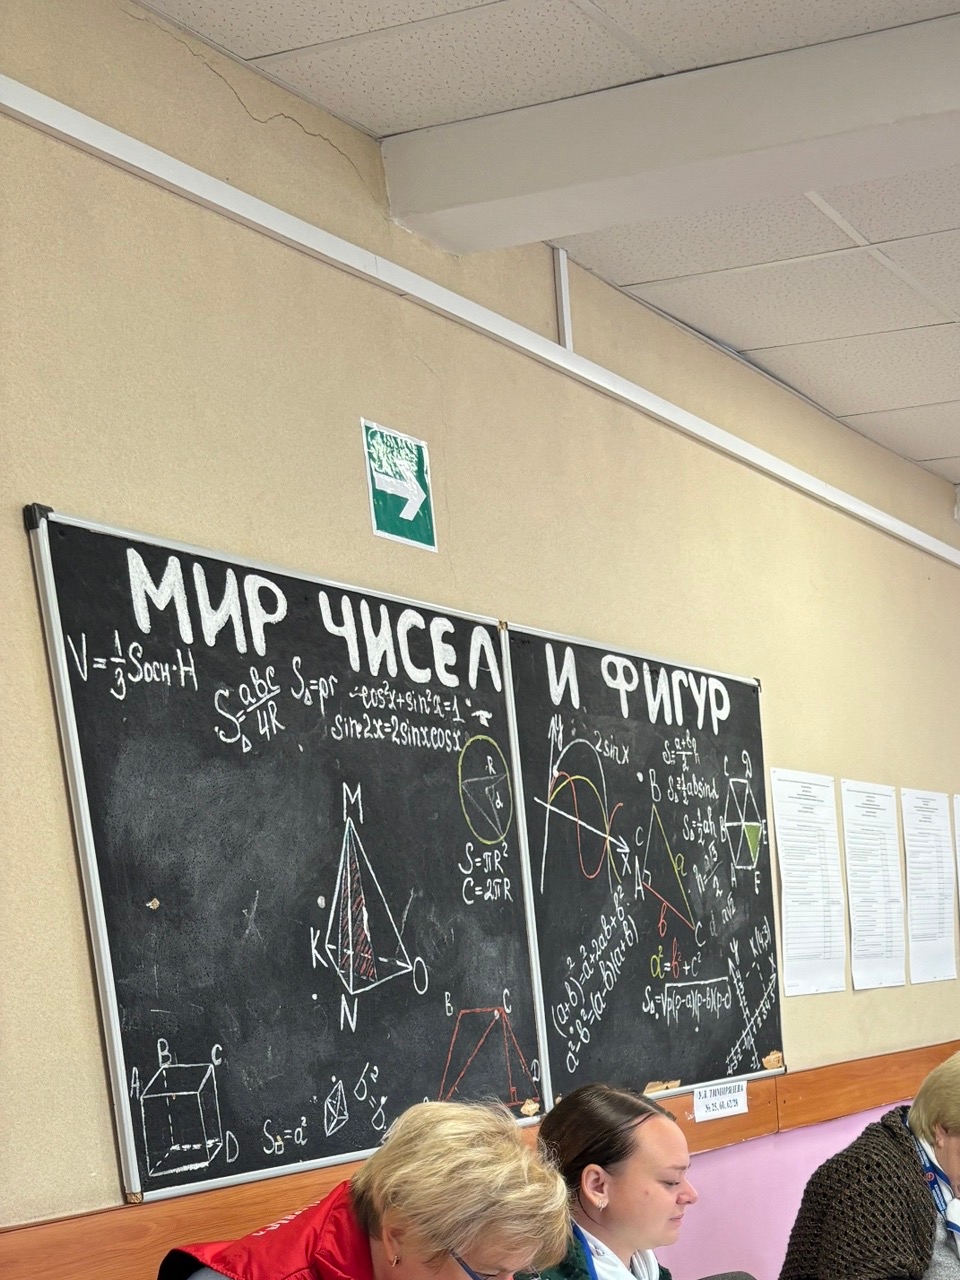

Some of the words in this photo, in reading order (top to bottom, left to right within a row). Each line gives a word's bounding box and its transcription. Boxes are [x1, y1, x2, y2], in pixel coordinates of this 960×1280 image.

[126, 547, 288, 657] МИР
[318, 590, 502, 692] ЧИСЕЛ
[545, 642, 580, 710] И
[600, 653, 731, 736] ФИГУР
[342, 782, 363, 824] M
[462, 877, 513, 905] C=2πR
[310, 927, 328, 968] K
[340, 994, 358, 1033] N
[503, 989, 512, 1014] C
[157, 1038, 172, 1067] B
[211, 1044, 223, 1065] C
[130, 1066, 141, 1098] A
[226, 1131, 240, 1163] D
